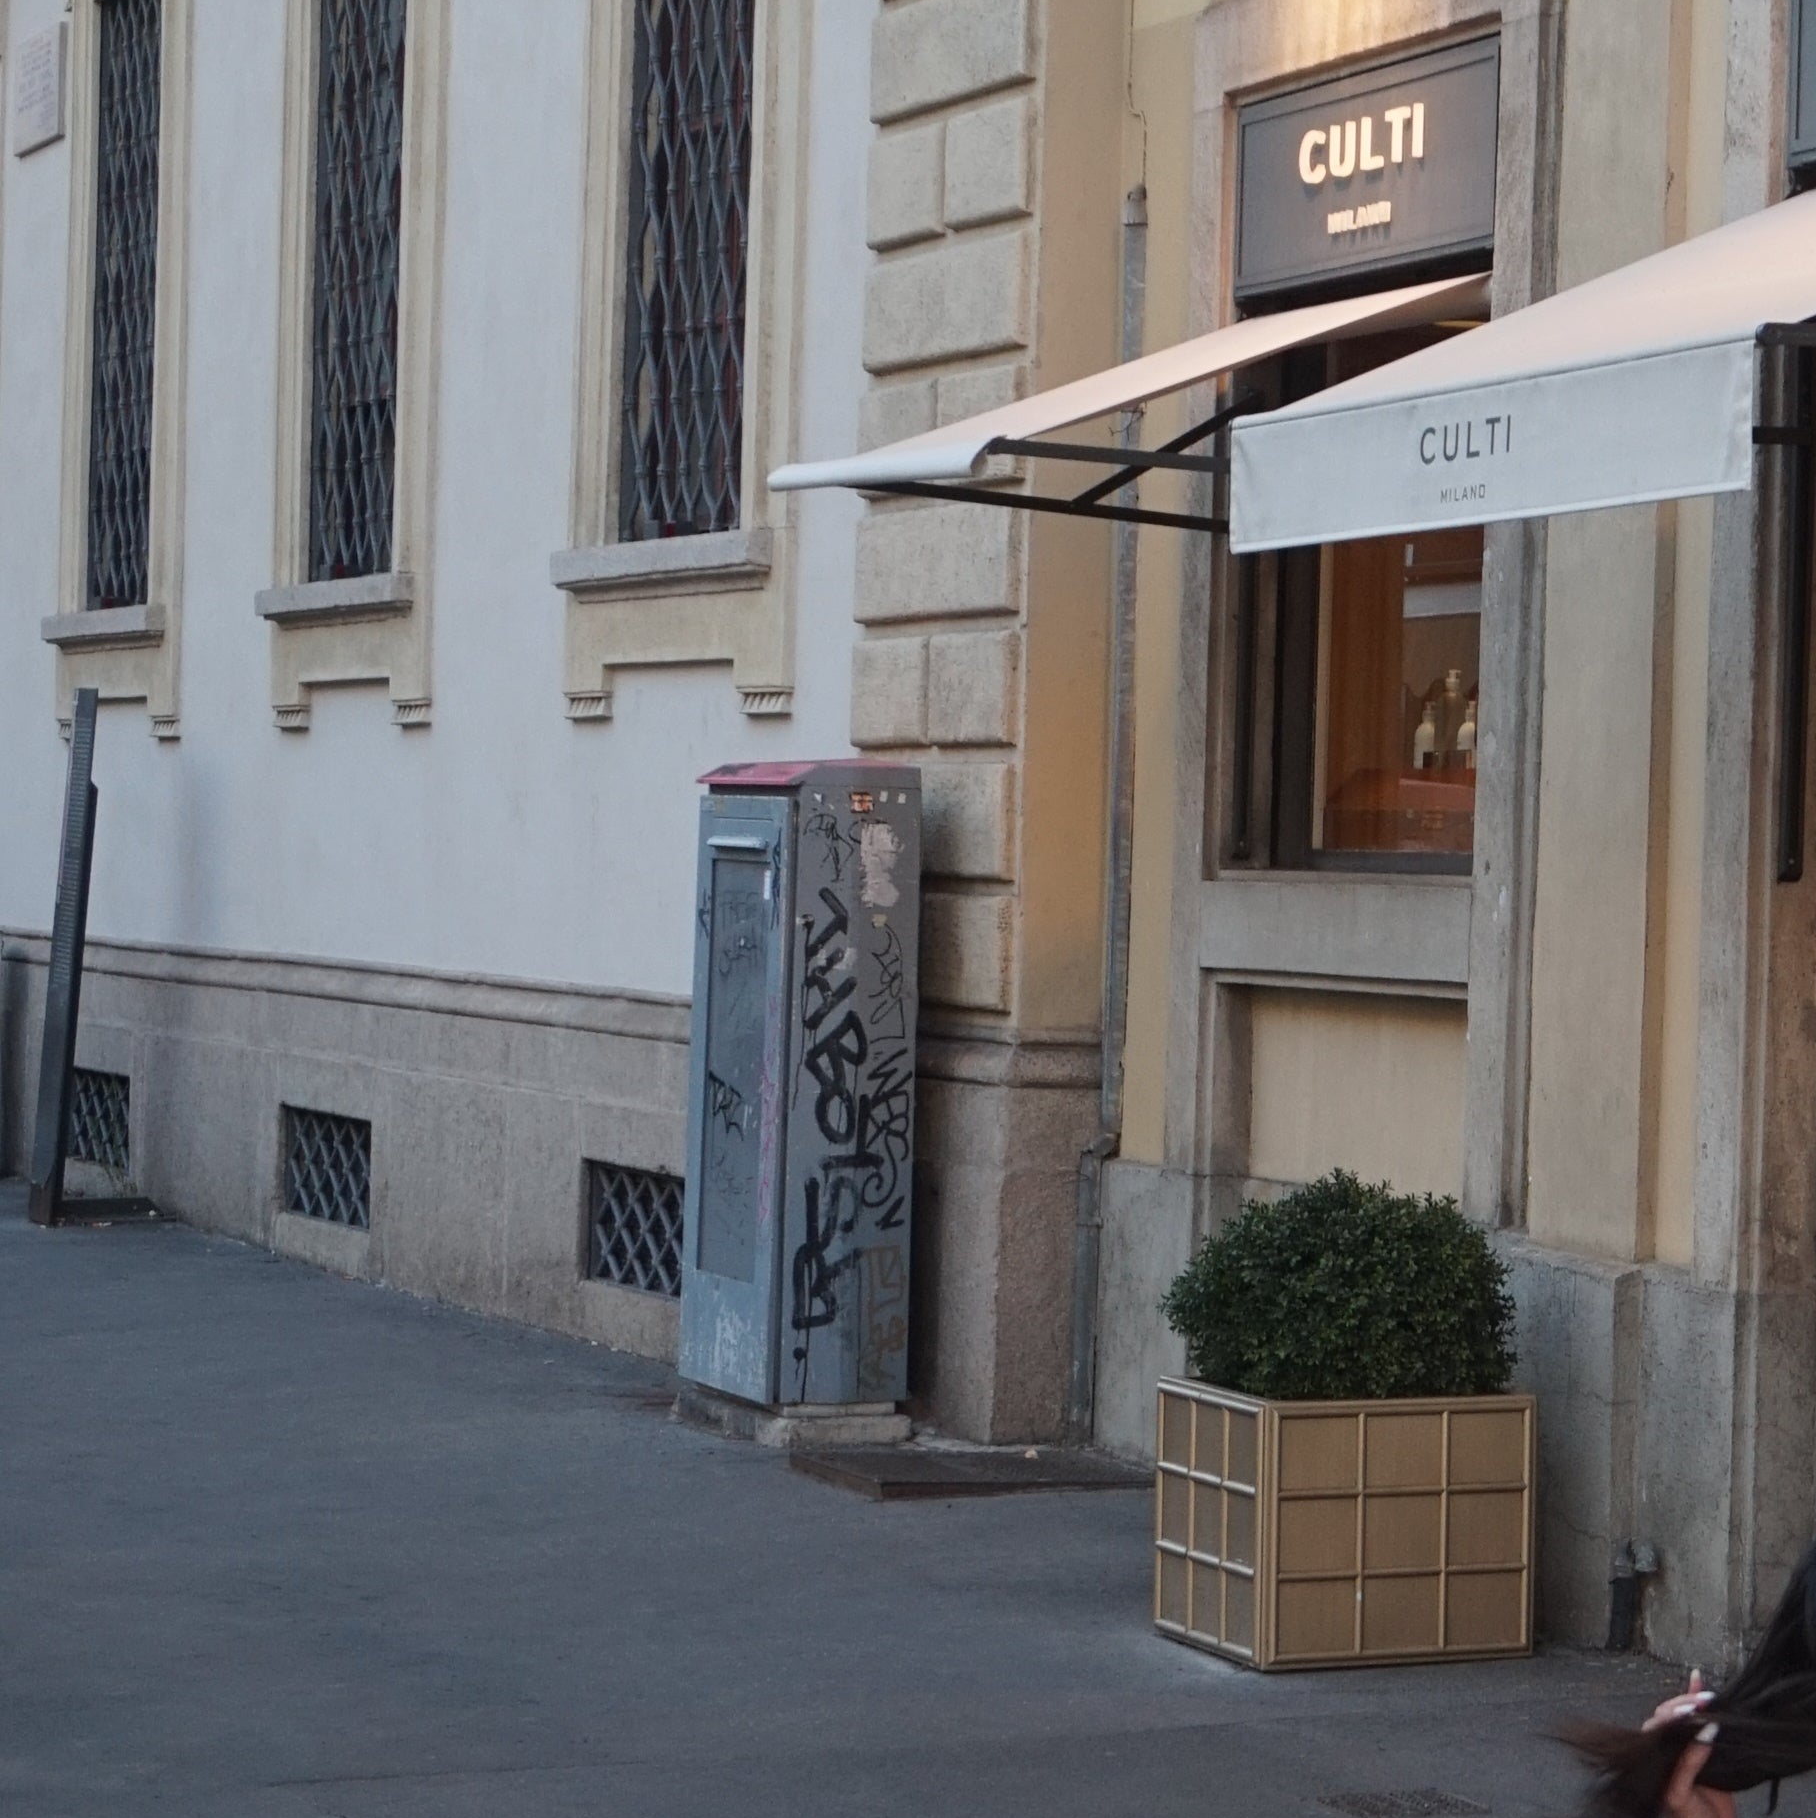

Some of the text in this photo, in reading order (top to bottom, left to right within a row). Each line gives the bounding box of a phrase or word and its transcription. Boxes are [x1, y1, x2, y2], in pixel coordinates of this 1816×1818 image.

[1298, 102, 1425, 184] CULTI
[1420, 414, 1512, 465] CULTI
[1440, 484, 1486, 503] MILANO
